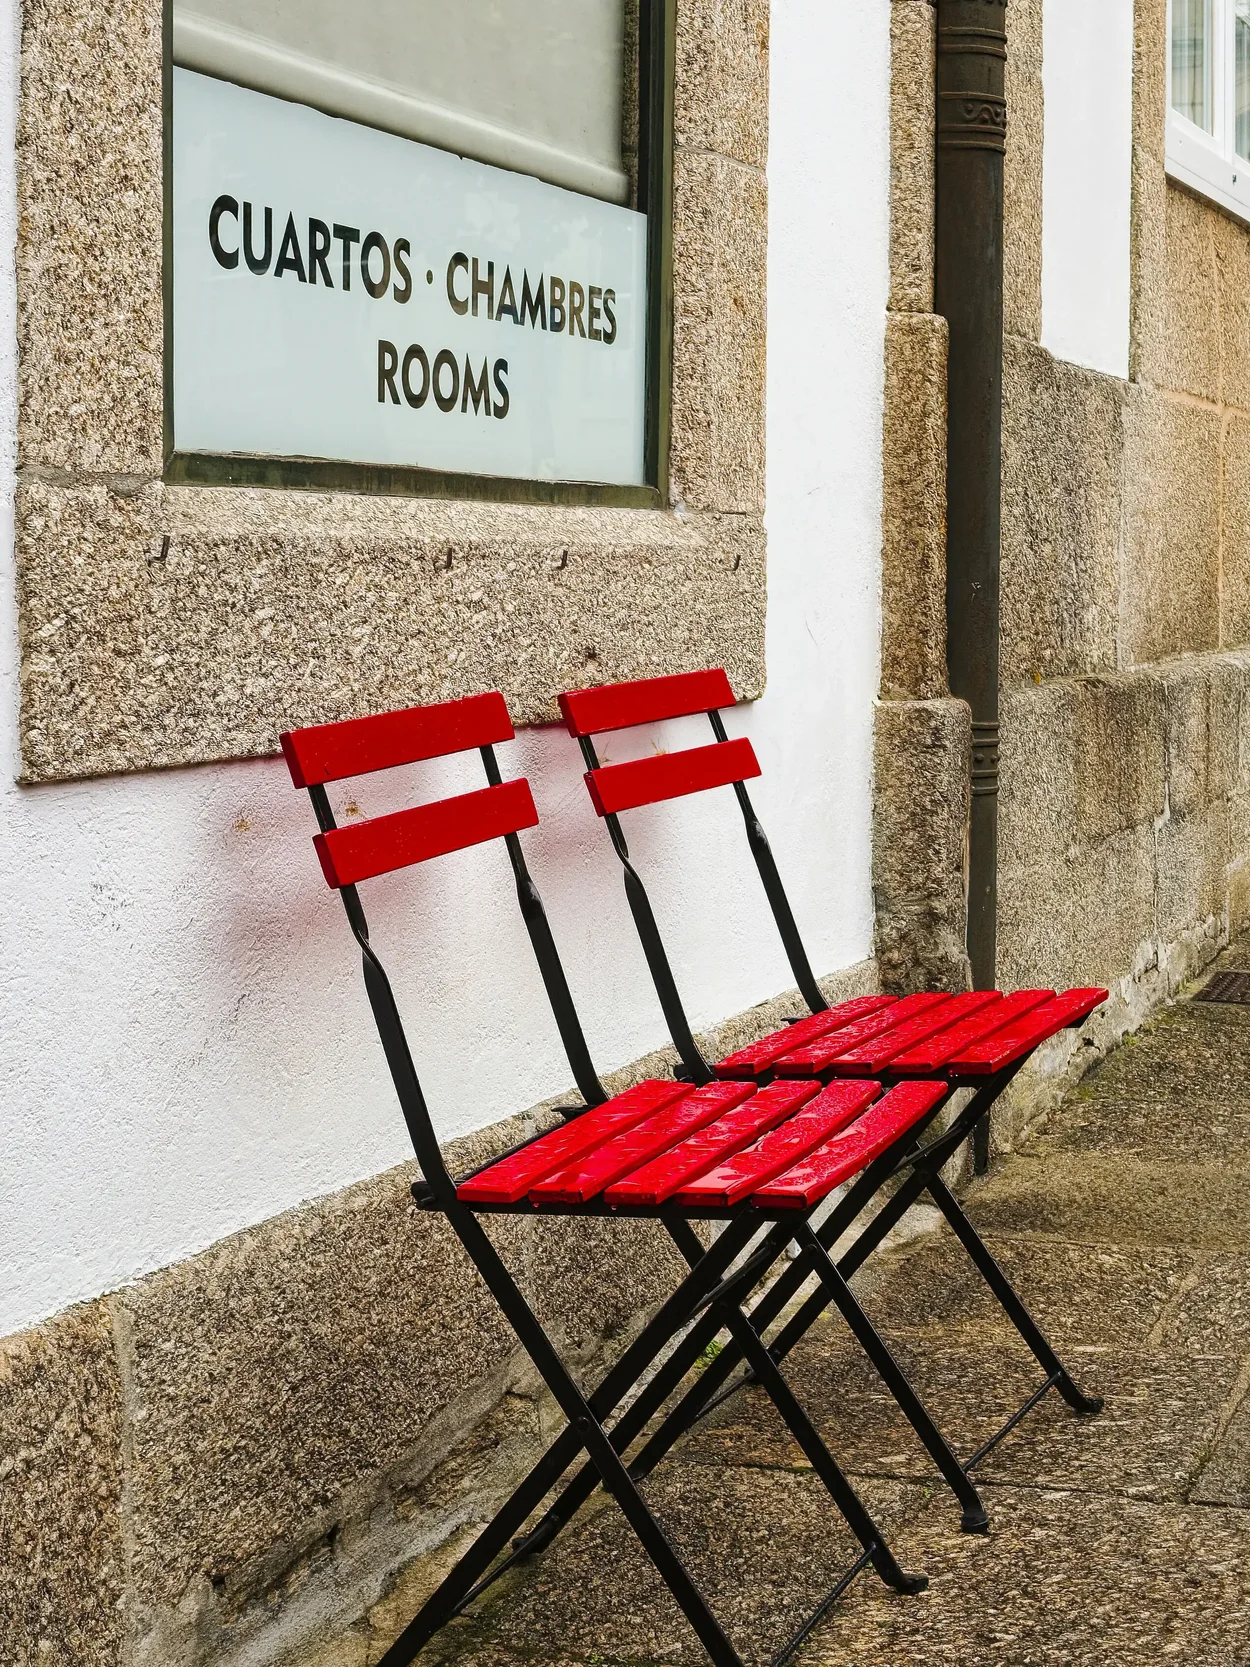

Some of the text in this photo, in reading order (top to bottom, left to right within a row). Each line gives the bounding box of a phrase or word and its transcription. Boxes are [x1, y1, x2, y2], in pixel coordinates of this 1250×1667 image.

[209, 194, 617, 345] CUARTOS CHAMBRES
[377, 339, 511, 420] ROOMS
